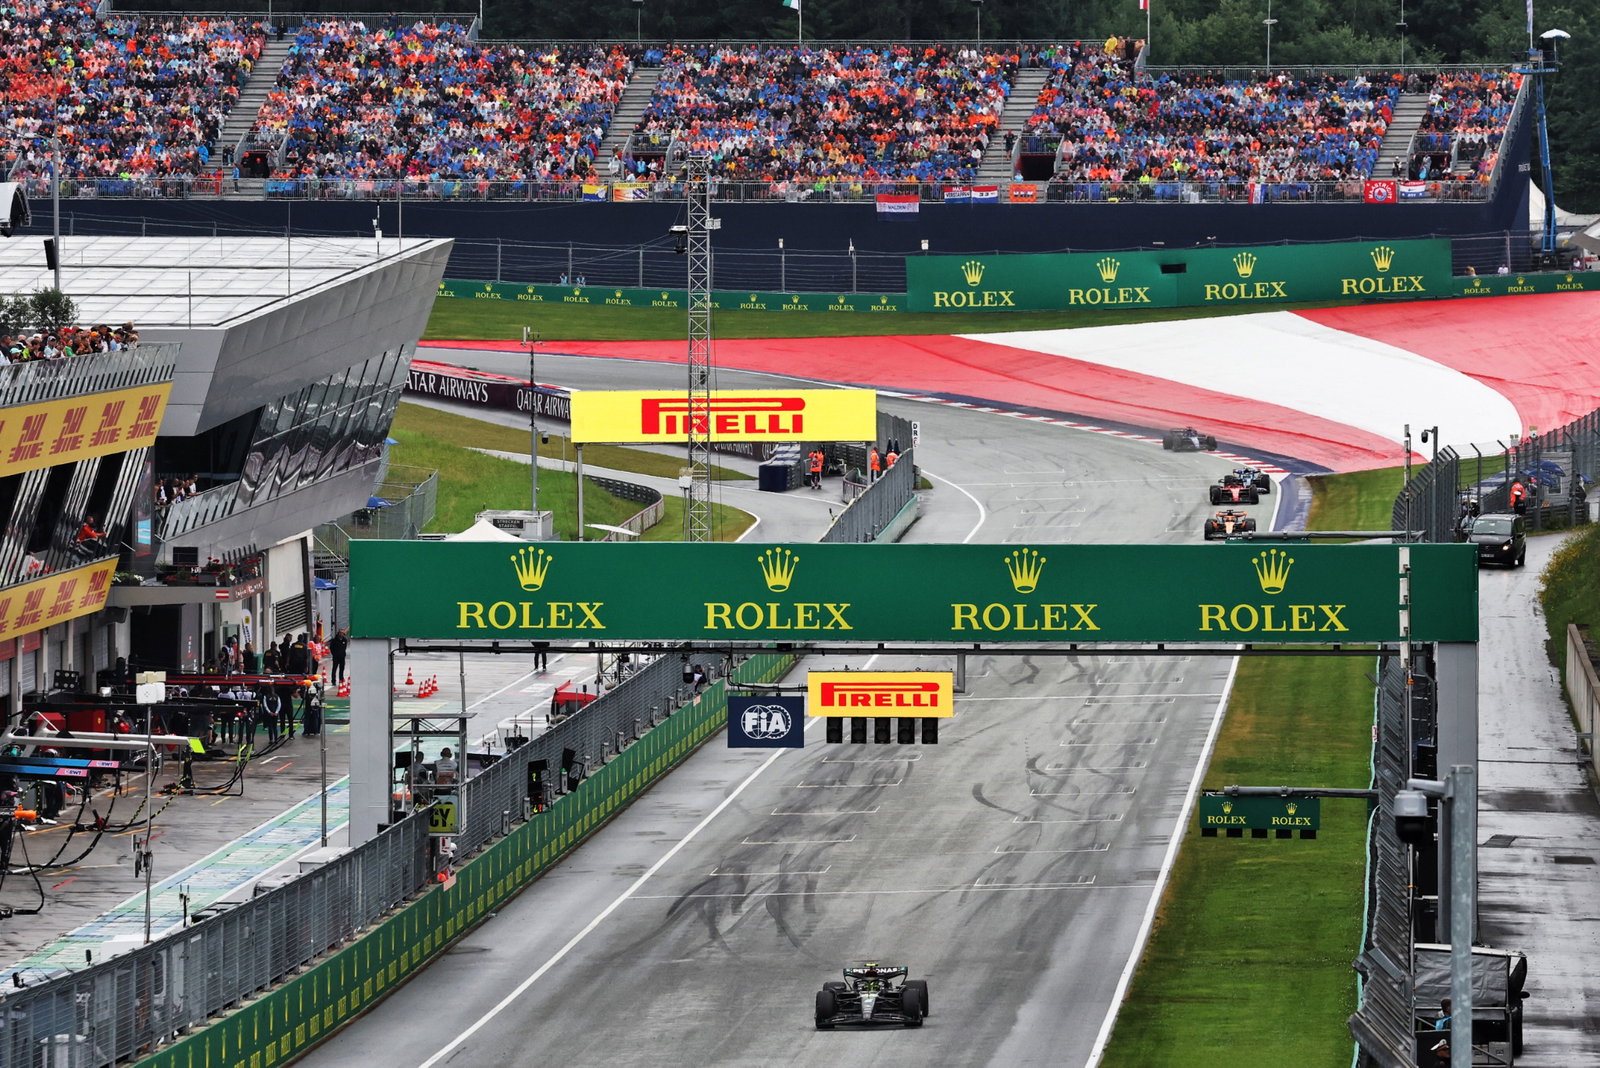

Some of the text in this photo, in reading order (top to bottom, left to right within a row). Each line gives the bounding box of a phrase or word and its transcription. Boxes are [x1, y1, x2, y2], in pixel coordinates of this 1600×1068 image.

[933, 276, 1425, 307] ROLEX ROLEX ROLEX ROLEX
[404, 371, 488, 402] ATAR AIRWAYS
[516, 389, 571, 419] QATAR AIRWA
[641, 397, 806, 434] PIRELLI
[456, 601, 1349, 632] ROLEX ROLEX ROLEX ROLEX
[821, 682, 940, 707] PIRELLI
[1207, 816, 1311, 826] ROLEX ROLEX
